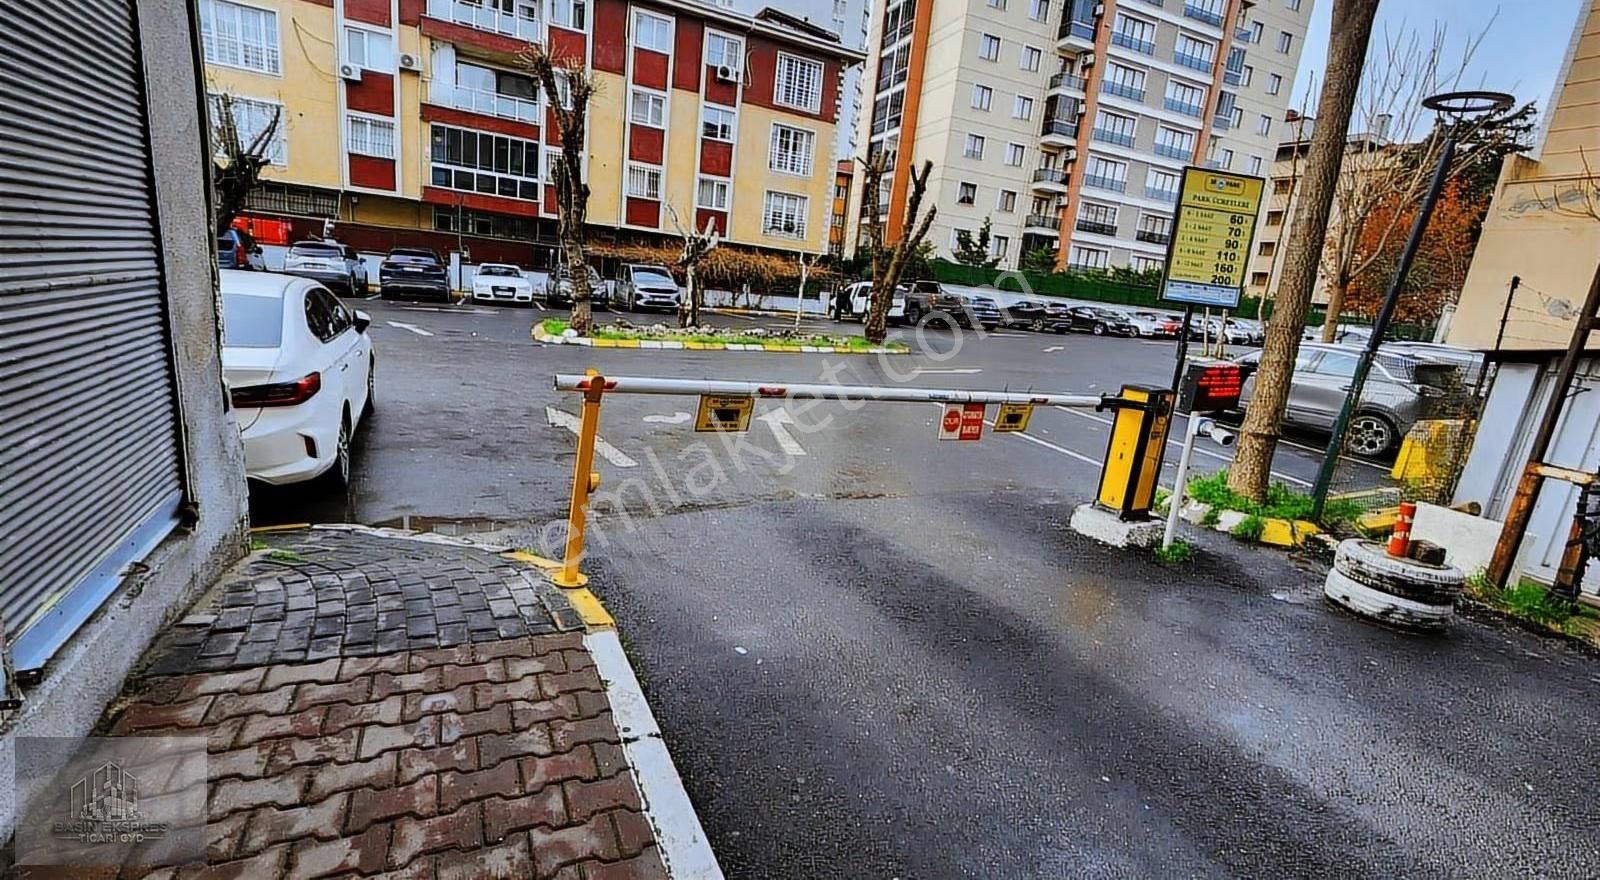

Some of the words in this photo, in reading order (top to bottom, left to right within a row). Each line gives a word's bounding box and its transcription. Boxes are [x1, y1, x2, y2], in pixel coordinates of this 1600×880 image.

[1192, 194, 1212, 204] PARK
[1230, 214, 1244, 225] 60
[1227, 226, 1241, 237] 70
[1225, 239, 1239, 249] 90
[1217, 251, 1236, 262] 110
[1214, 263, 1234, 273] 160
[1210, 274, 1231, 285] 200
